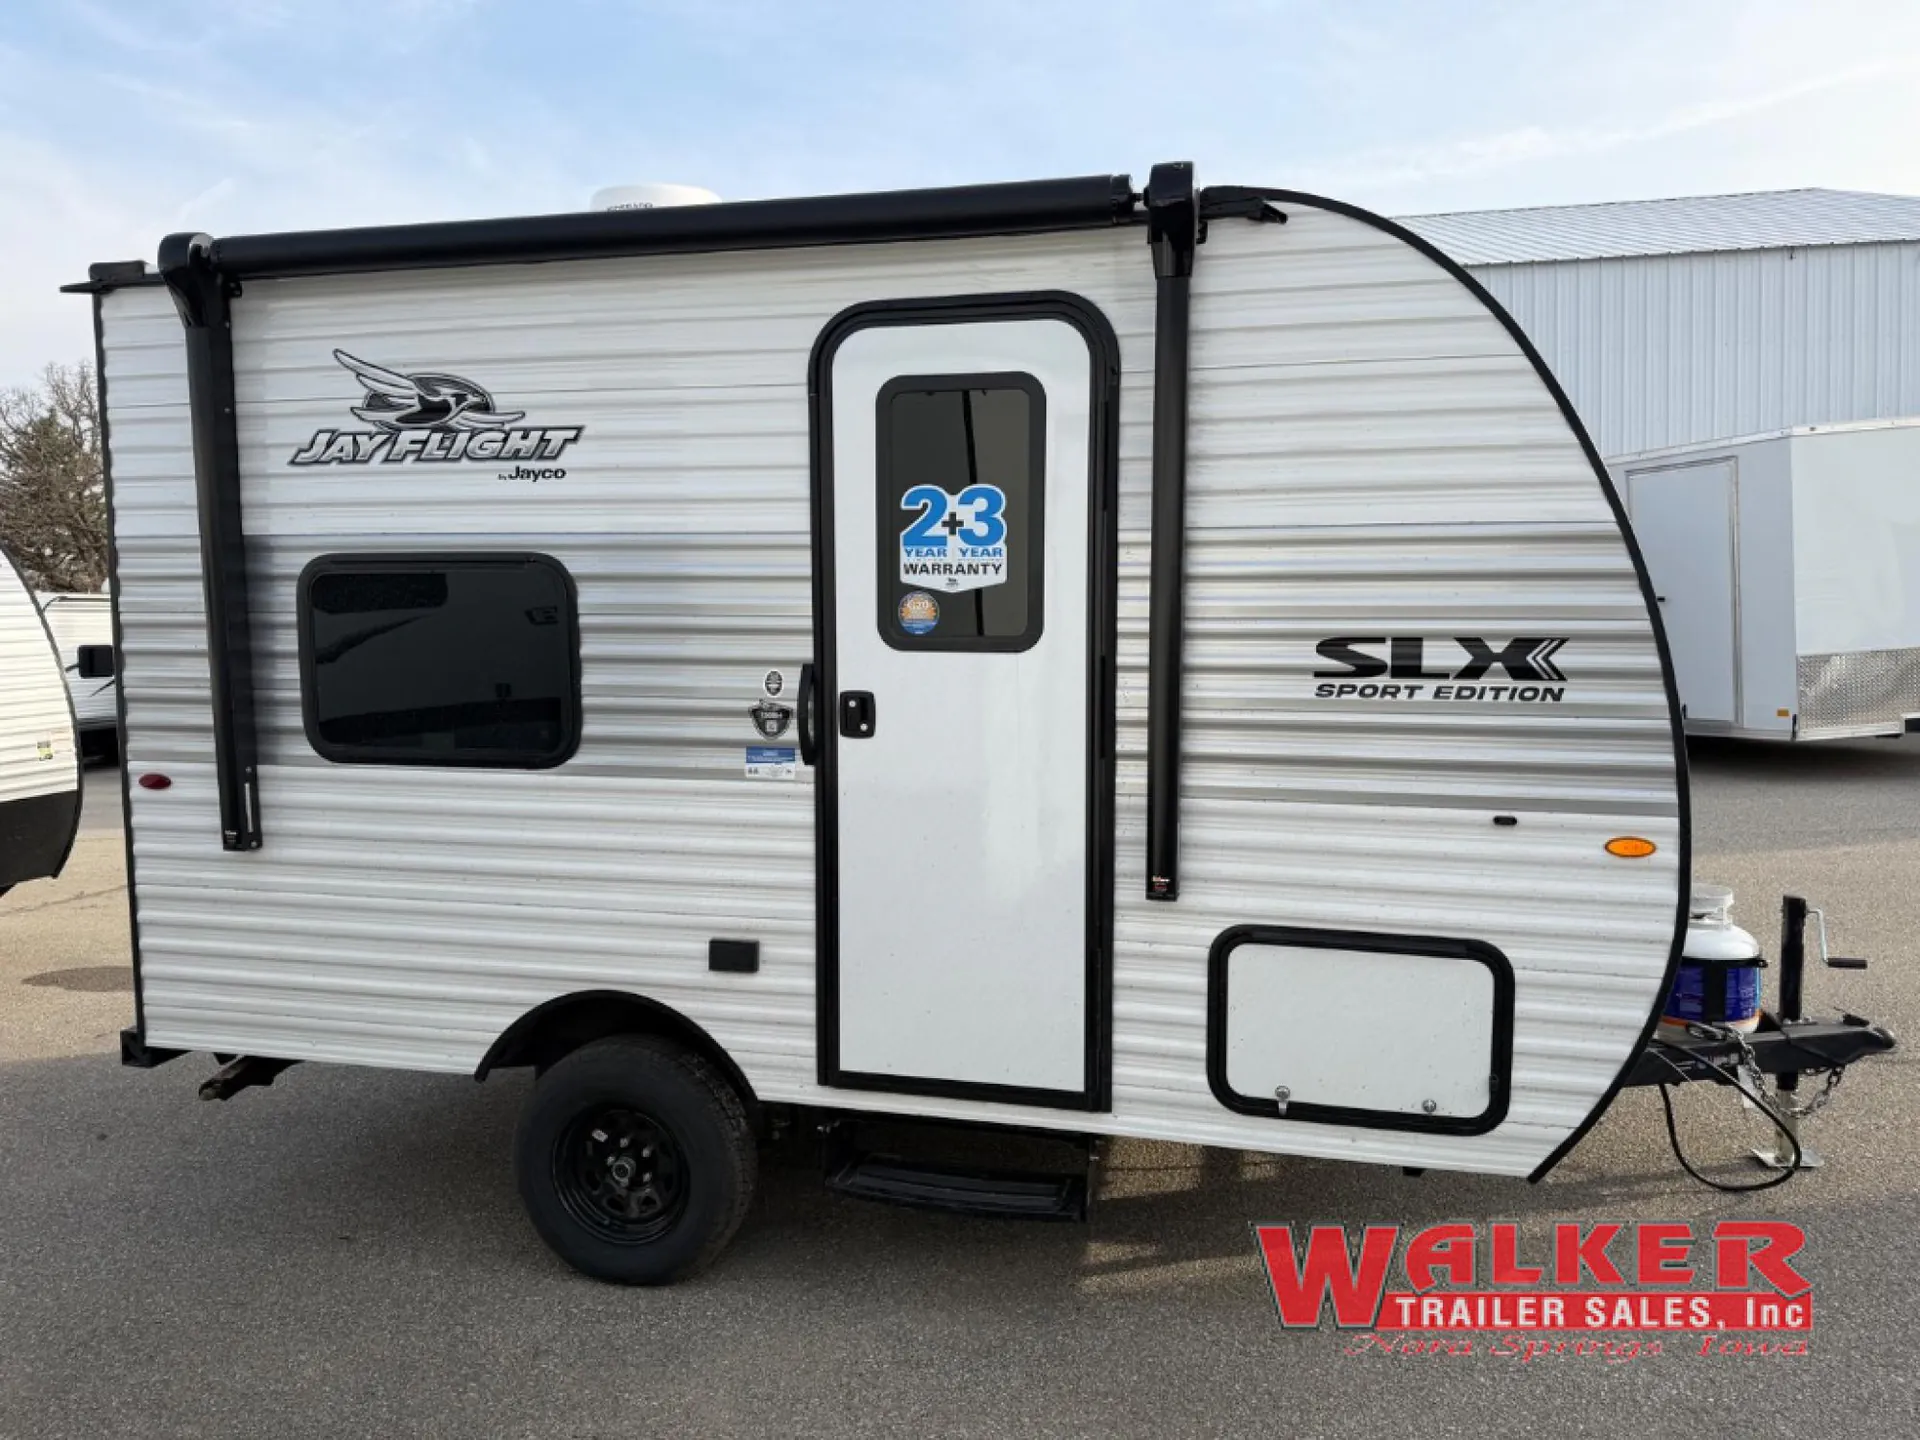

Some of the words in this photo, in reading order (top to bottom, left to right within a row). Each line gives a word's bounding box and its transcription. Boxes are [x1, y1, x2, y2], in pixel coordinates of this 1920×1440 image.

[508, 464, 567, 482] Jayco
[904, 548, 948, 557] YEAR
[958, 547, 1003, 557] YEAR
[903, 563, 1002, 575] WARRANTY
[1314, 637, 1570, 681] SLX
[1315, 683, 1424, 700] SPORT
[1432, 686, 1565, 702] EDITION
